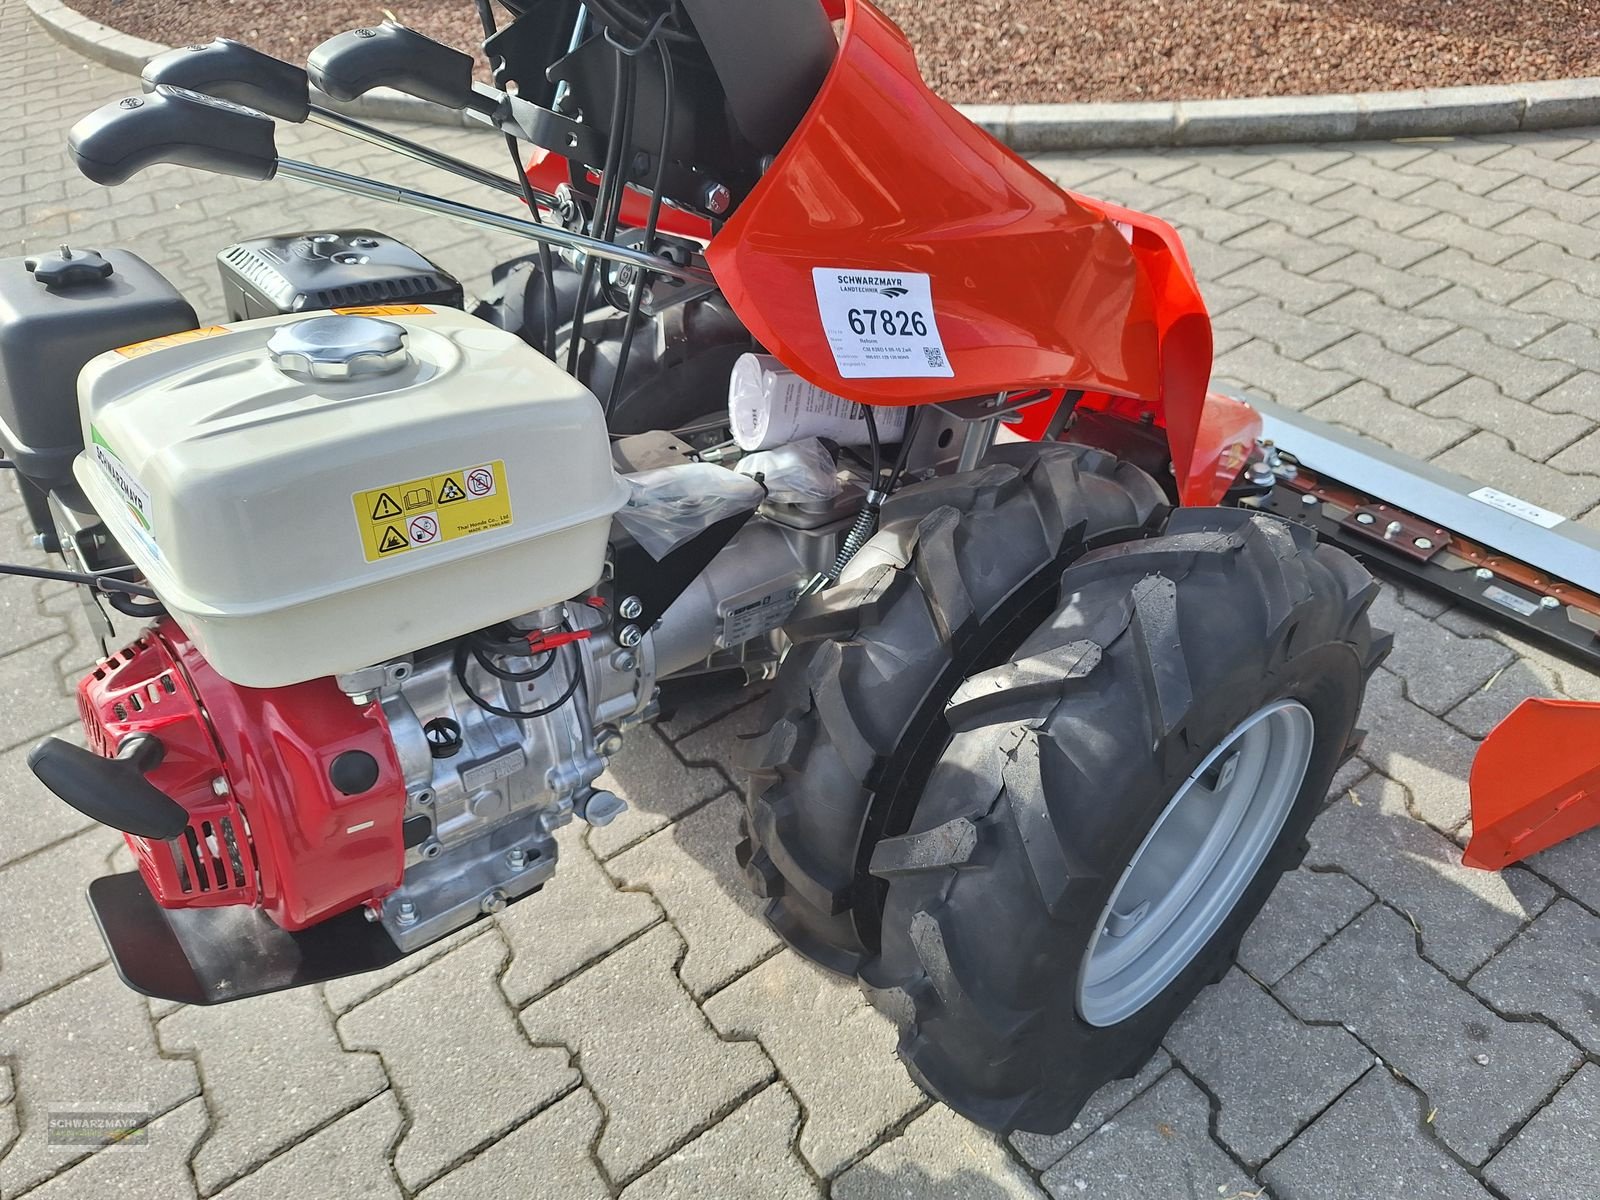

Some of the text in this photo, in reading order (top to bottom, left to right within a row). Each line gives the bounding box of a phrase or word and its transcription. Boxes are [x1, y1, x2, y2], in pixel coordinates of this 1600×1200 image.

[837, 275, 902, 286] SCHWARZMAYR
[848, 308, 927, 336] 67826
[96, 445, 144, 513] SCHWARZMAYR
[489, 520, 510, 528] THAILAND
